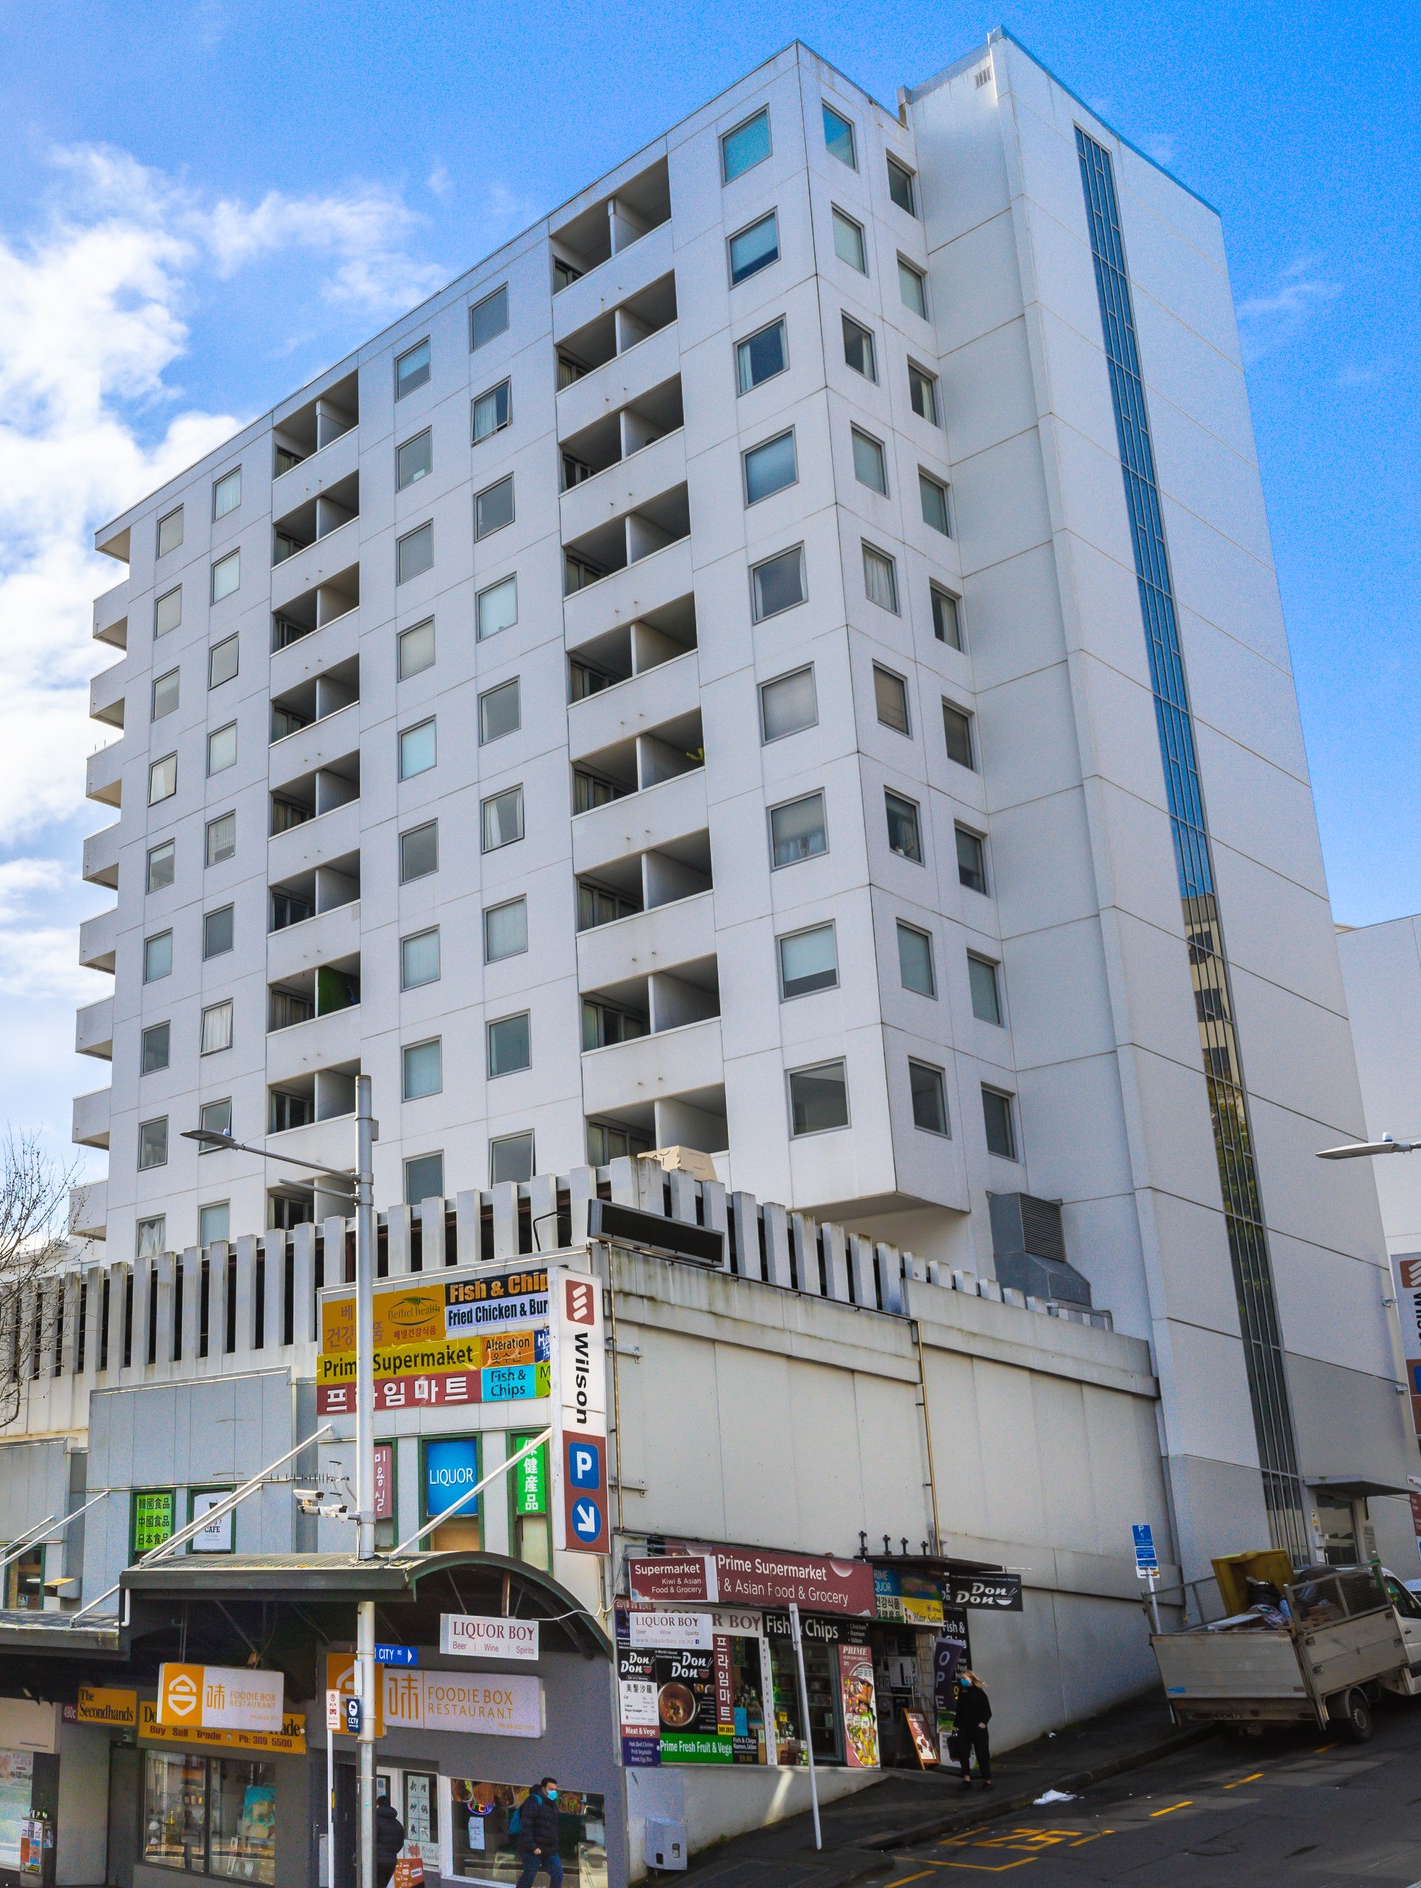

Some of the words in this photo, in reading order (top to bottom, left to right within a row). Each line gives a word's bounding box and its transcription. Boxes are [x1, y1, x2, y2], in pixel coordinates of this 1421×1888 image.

[450, 1281, 487, 1303] Fish
[491, 1281, 505, 1297] &
[508, 1272, 548, 1294] Chip
[387, 1306, 414, 1321] Bethel
[416, 1303, 441, 1316] health
[448, 1307, 473, 1327] Fried
[475, 1302, 518, 1323] Chicken
[520, 1302, 527, 1316] &
[529, 1298, 548, 1316] Bur
[485, 1337, 531, 1352] Alteration
[323, 1358, 357, 1378] Prim
[372, 1344, 474, 1375] Supermaket
[491, 1367, 515, 1382] Fish
[520, 1369, 527, 1381] &
[575, 1332, 589, 1425] Wilson
[326, 1377, 469, 1412] 프임마트
[490, 1384, 526, 1399] Chips
[576, 1451, 592, 1479] P
[429, 1467, 474, 1487] LIQUOR
[634, 1563, 701, 1576] Supermarket
[718, 1554, 752, 1572] Prime
[755, 1558, 827, 1581] Supermarket
[683, 1577, 702, 1585] Asian
[676, 1586, 702, 1595] Grocery
[723, 1577, 732, 1593] &
[735, 1579, 765, 1596] Asian
[768, 1582, 795, 1599] Food
[798, 1585, 806, 1600] &
[808, 1586, 849, 1608] Grocery
[972, 1582, 1008, 1596] Don
[955, 1591, 995, 1605] Don
[635, 1616, 676, 1627] LIQUOR
[678, 1617, 699, 1627] BOY
[729, 1614, 761, 1632] BOY
[766, 1615, 791, 1634] Fish
[805, 1618, 839, 1643] Chips
[453, 1621, 505, 1640] LIQUOR
[508, 1625, 535, 1641] BOY
[684, 1629, 700, 1637] Spirits
[379, 1648, 395, 1661] CITY
[452, 1641, 467, 1650] Beer
[483, 1643, 499, 1652] Wine
[515, 1645, 535, 1655] Spirits
[842, 1646, 868, 1656] PRIME
[629, 1652, 650, 1665] Don
[682, 1652, 707, 1667] Don
[620, 1660, 643, 1673] Don
[671, 1662, 698, 1678] Don
[716, 1636, 732, 1721] 프라임마트
[81, 1689, 94, 1701] The
[230, 1689, 259, 1701] FOODIE
[260, 1692, 276, 1702] BOX
[428, 1686, 480, 1703] FOODIE
[484, 1689, 513, 1706] BOX
[230, 1700, 276, 1710] RESTAURANT
[428, 1703, 514, 1720] RESTAURANT
[79, 1704, 134, 1722] Secondhands
[348, 1718, 359, 1726] CCTV
[149, 1725, 166, 1737] Buy
[172, 1727, 189, 1737] Sell
[196, 1729, 222, 1741] Trade
[238, 1733, 251, 1744] Ph:
[625, 1726, 640, 1736] Meat
[640, 1727, 645, 1736] &
[645, 1727, 656, 1738] Vege
[660, 1740, 678, 1752] Prime
[679, 1740, 696, 1753] Fresh
[696, 1741, 711, 1754] Fruit
[712, 1742, 718, 1754] &
[718, 1743, 733, 1756] Vege
